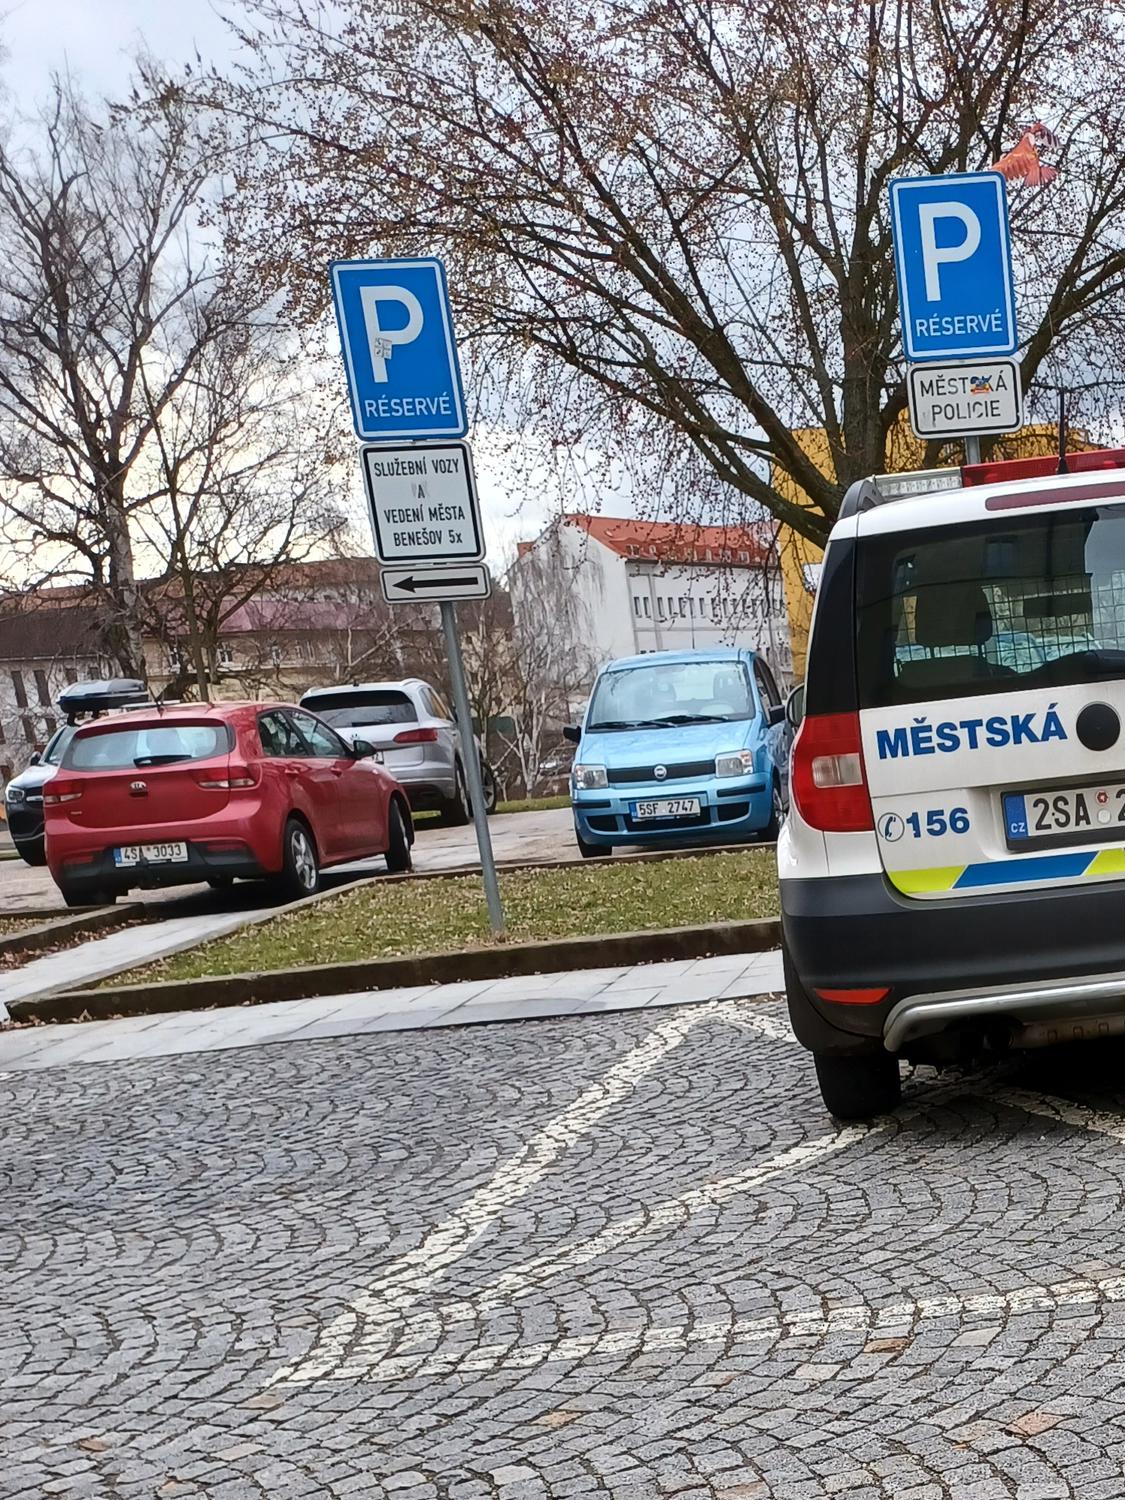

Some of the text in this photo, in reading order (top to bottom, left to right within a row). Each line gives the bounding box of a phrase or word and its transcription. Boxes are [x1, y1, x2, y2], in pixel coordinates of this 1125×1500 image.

[918, 201, 981, 302] P
[360, 285, 424, 383] P
[915, 309, 1003, 337] RÉSERVÉ
[919, 370, 1008, 398] MĚSTÁ
[364, 392, 452, 417] RÉSERVÉ
[931, 400, 1001, 421] POLICIE
[374, 456, 459, 477] SLUŽEBNÍ VOZY
[418, 484, 426, 499] A
[384, 503, 465, 523] VEDENÍ MĚSTA
[393, 528, 463, 547] BENEŠOV 5x
[876, 702, 1068, 760] MĚSTSKÁ
[639, 803, 659, 816] 5SF
[667, 800, 694, 814] 2747
[1033, 793, 1091, 831] 2SA
[905, 807, 971, 838] 156
[1011, 822, 1026, 834] CZ
[153, 844, 182, 858] 3033
